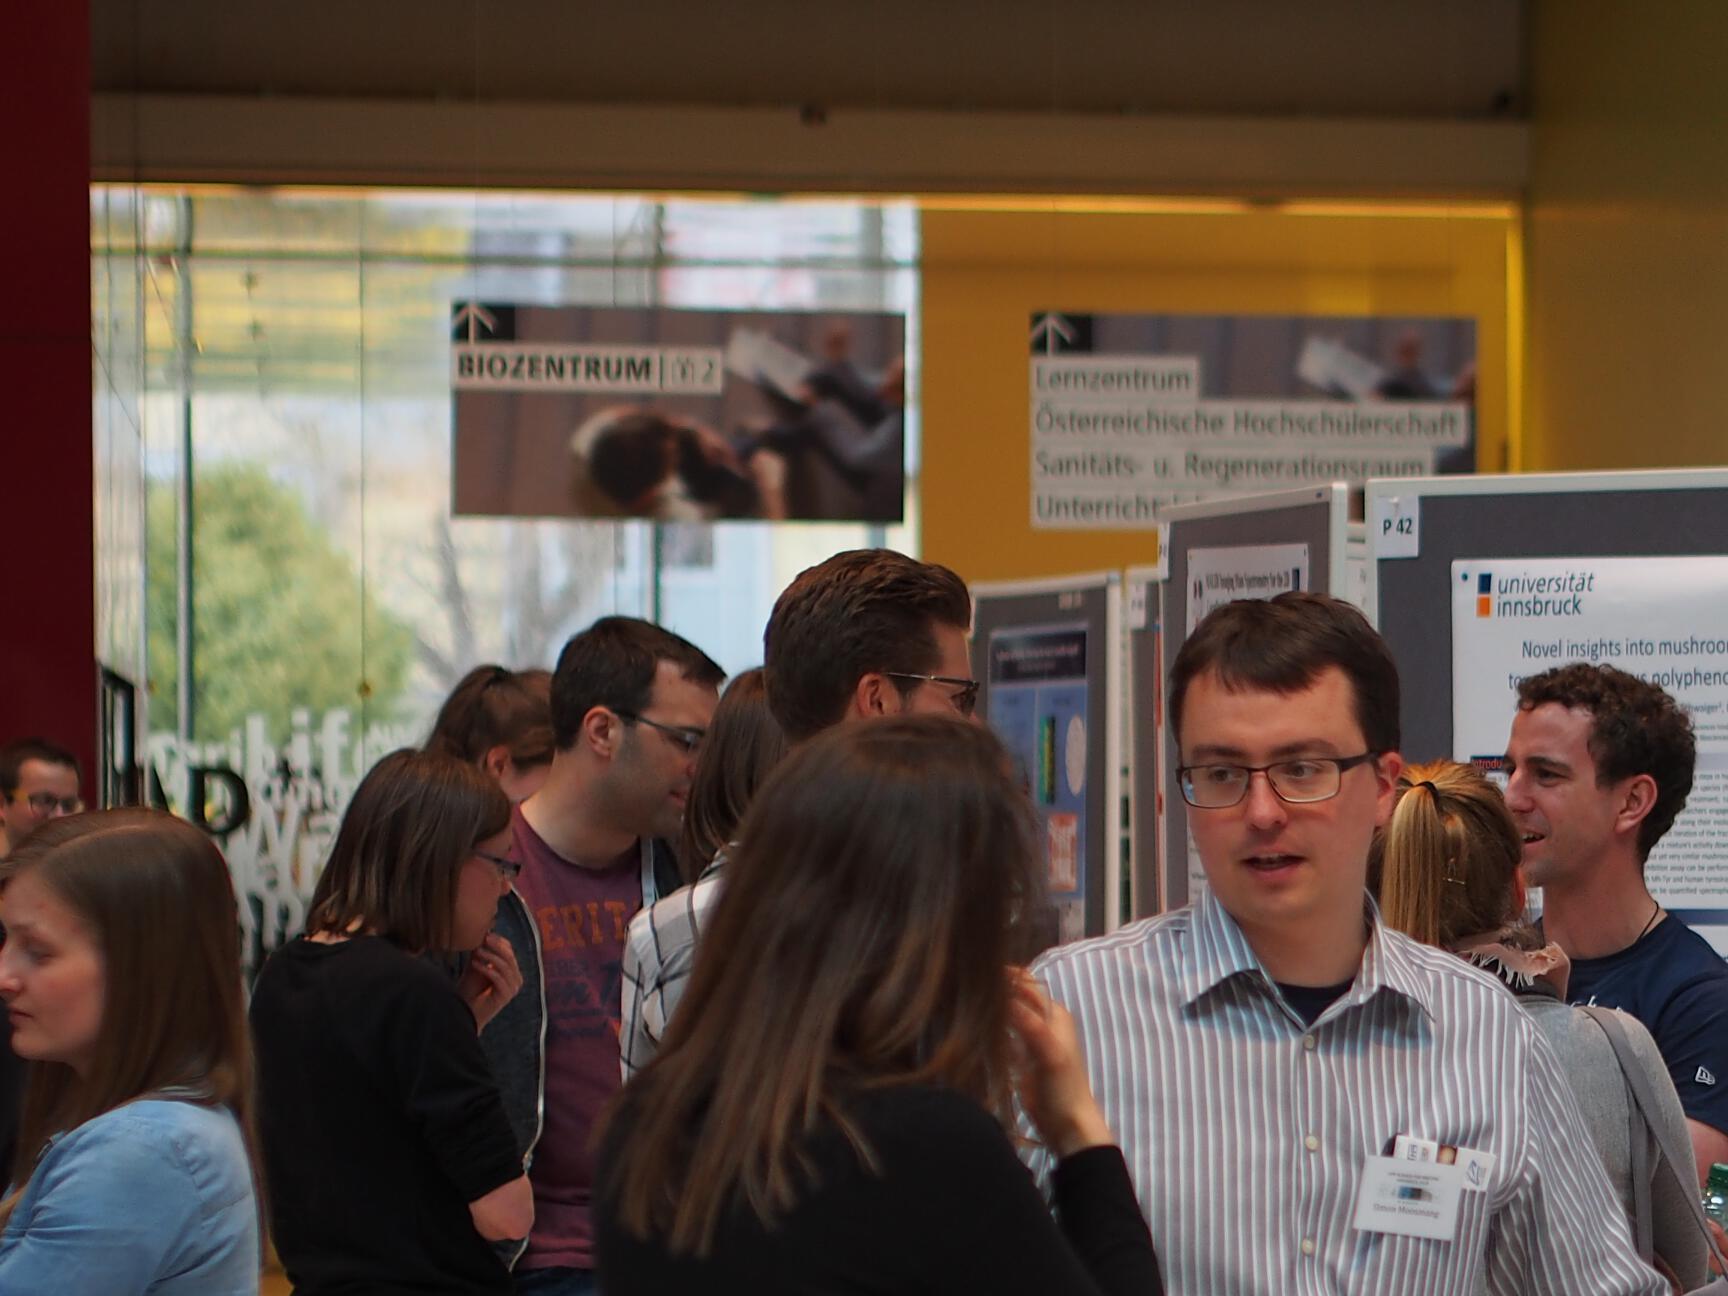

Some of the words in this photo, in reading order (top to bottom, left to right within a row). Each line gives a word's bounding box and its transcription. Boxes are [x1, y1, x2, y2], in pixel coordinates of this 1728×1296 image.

[457, 353, 651, 381] BIOZENTRUM
[1036, 365, 1190, 390] Lernzentrum
[1036, 404, 1225, 435] Österreichische
[1233, 408, 1458, 437] Hochschülerschaft
[1036, 451, 1142, 477] Sanitäts-
[1185, 453, 1424, 483] Regenerationsraum
[1383, 518, 1392, 535] P
[1396, 517, 1413, 534] 42
[1498, 572, 1594, 594] universität
[1497, 595, 1582, 617] innsbruck
[1522, 640, 1562, 658] Novel
[1567, 639, 1621, 660] insights
[1626, 638, 1654, 656] into
